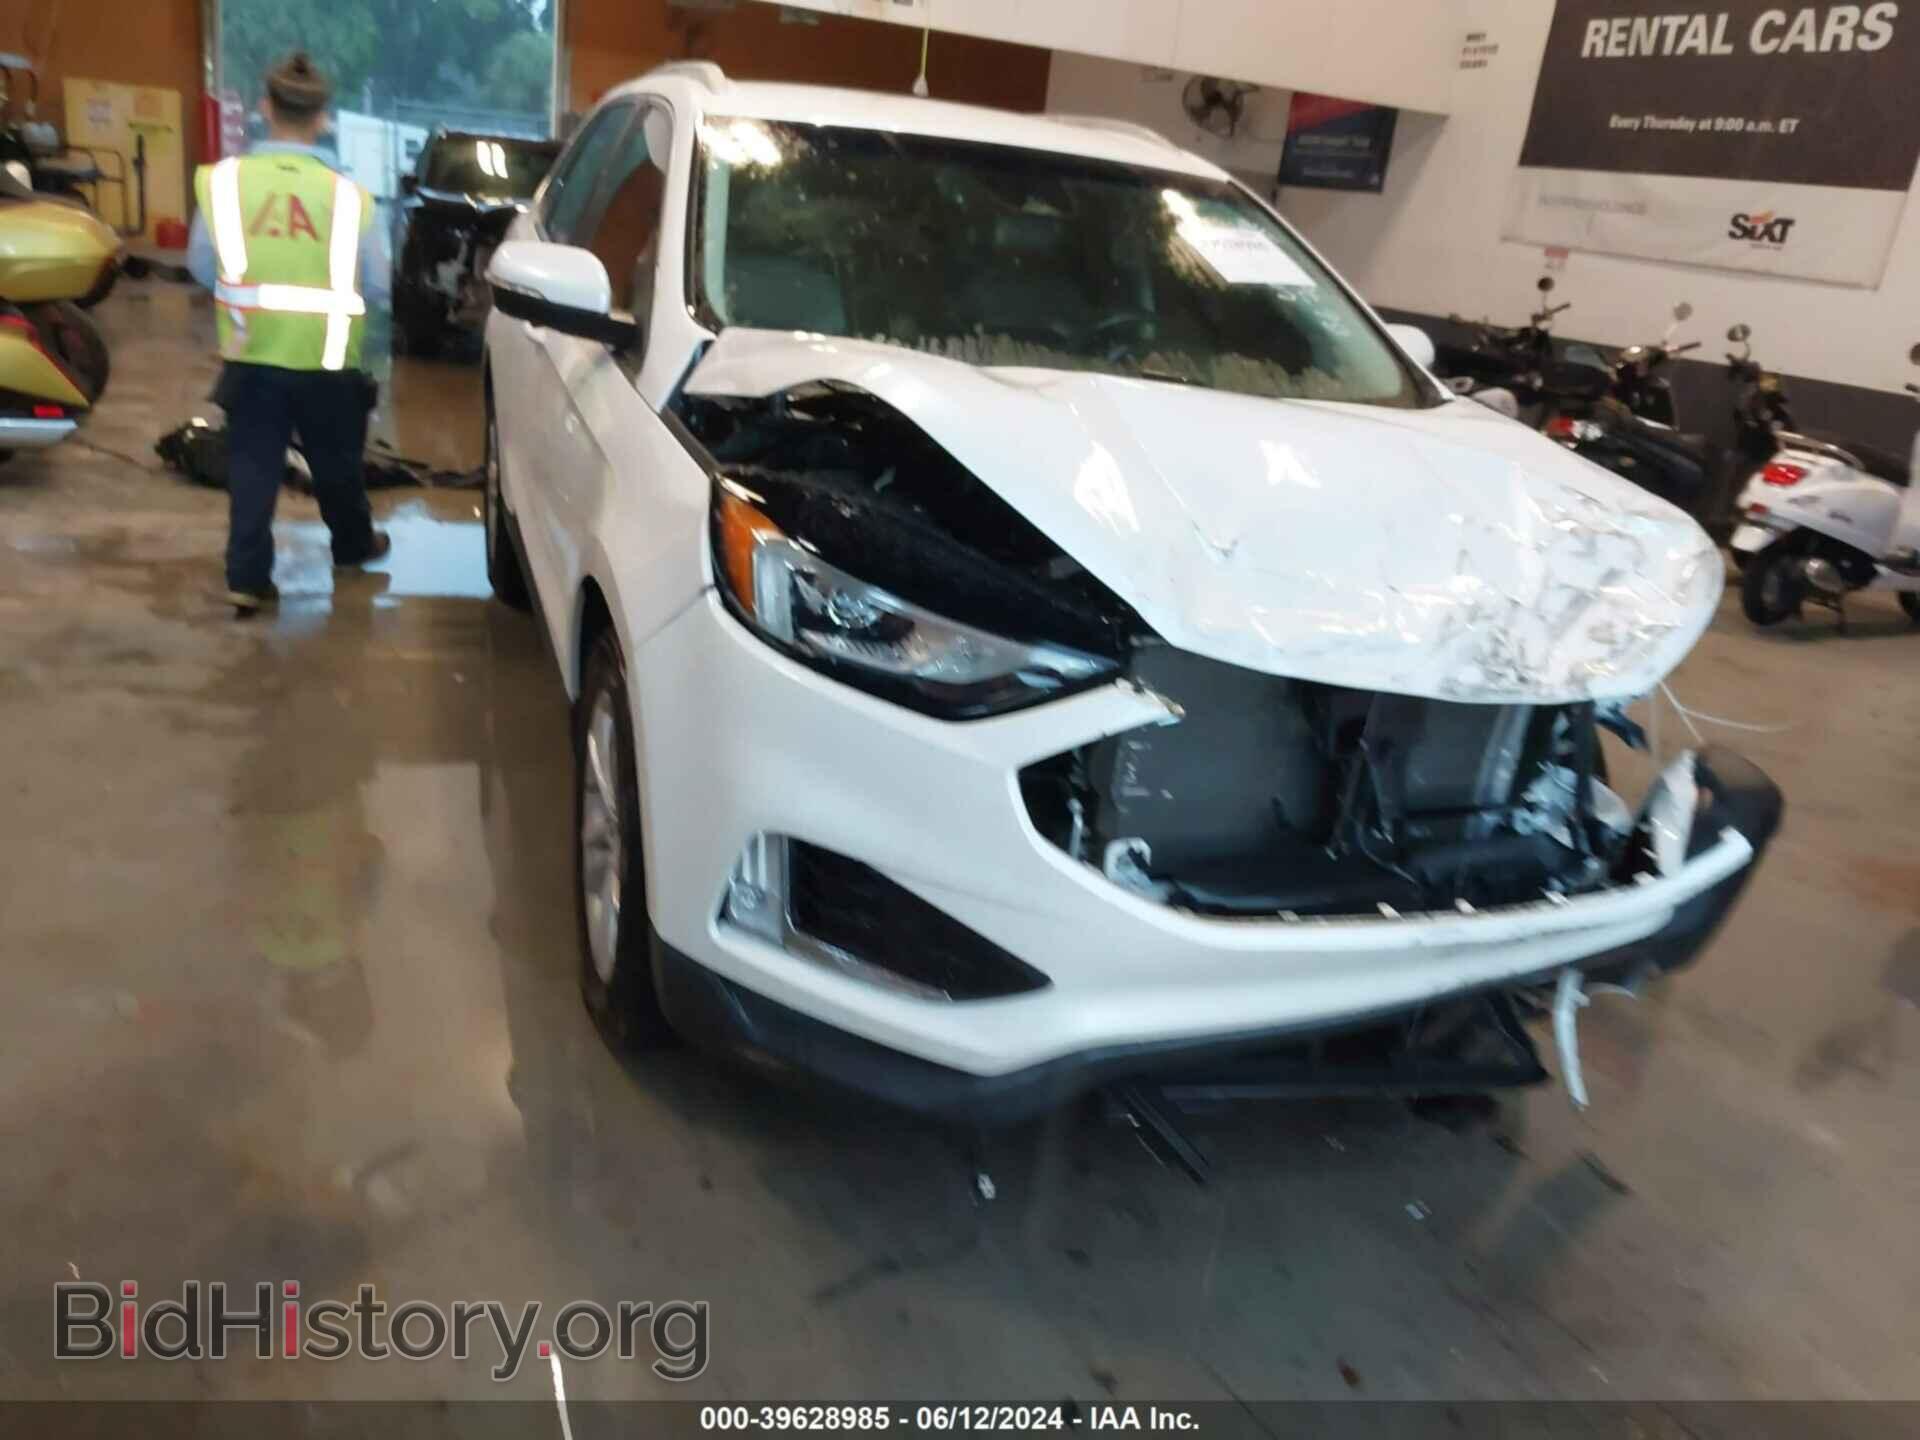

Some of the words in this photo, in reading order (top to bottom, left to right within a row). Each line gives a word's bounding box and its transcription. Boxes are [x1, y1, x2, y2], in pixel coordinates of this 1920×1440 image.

[1581, 13, 1734, 58] RENTAL
[1750, 2, 1899, 54] CARS
[1609, 114, 1641, 131] Every
[1643, 115, 1697, 134] Thursday
[1698, 117, 1712, 130] at
[1713, 116, 1745, 132] 9:00
[1745, 120, 1774, 133] a.m.
[1778, 117, 1800, 134] ET
